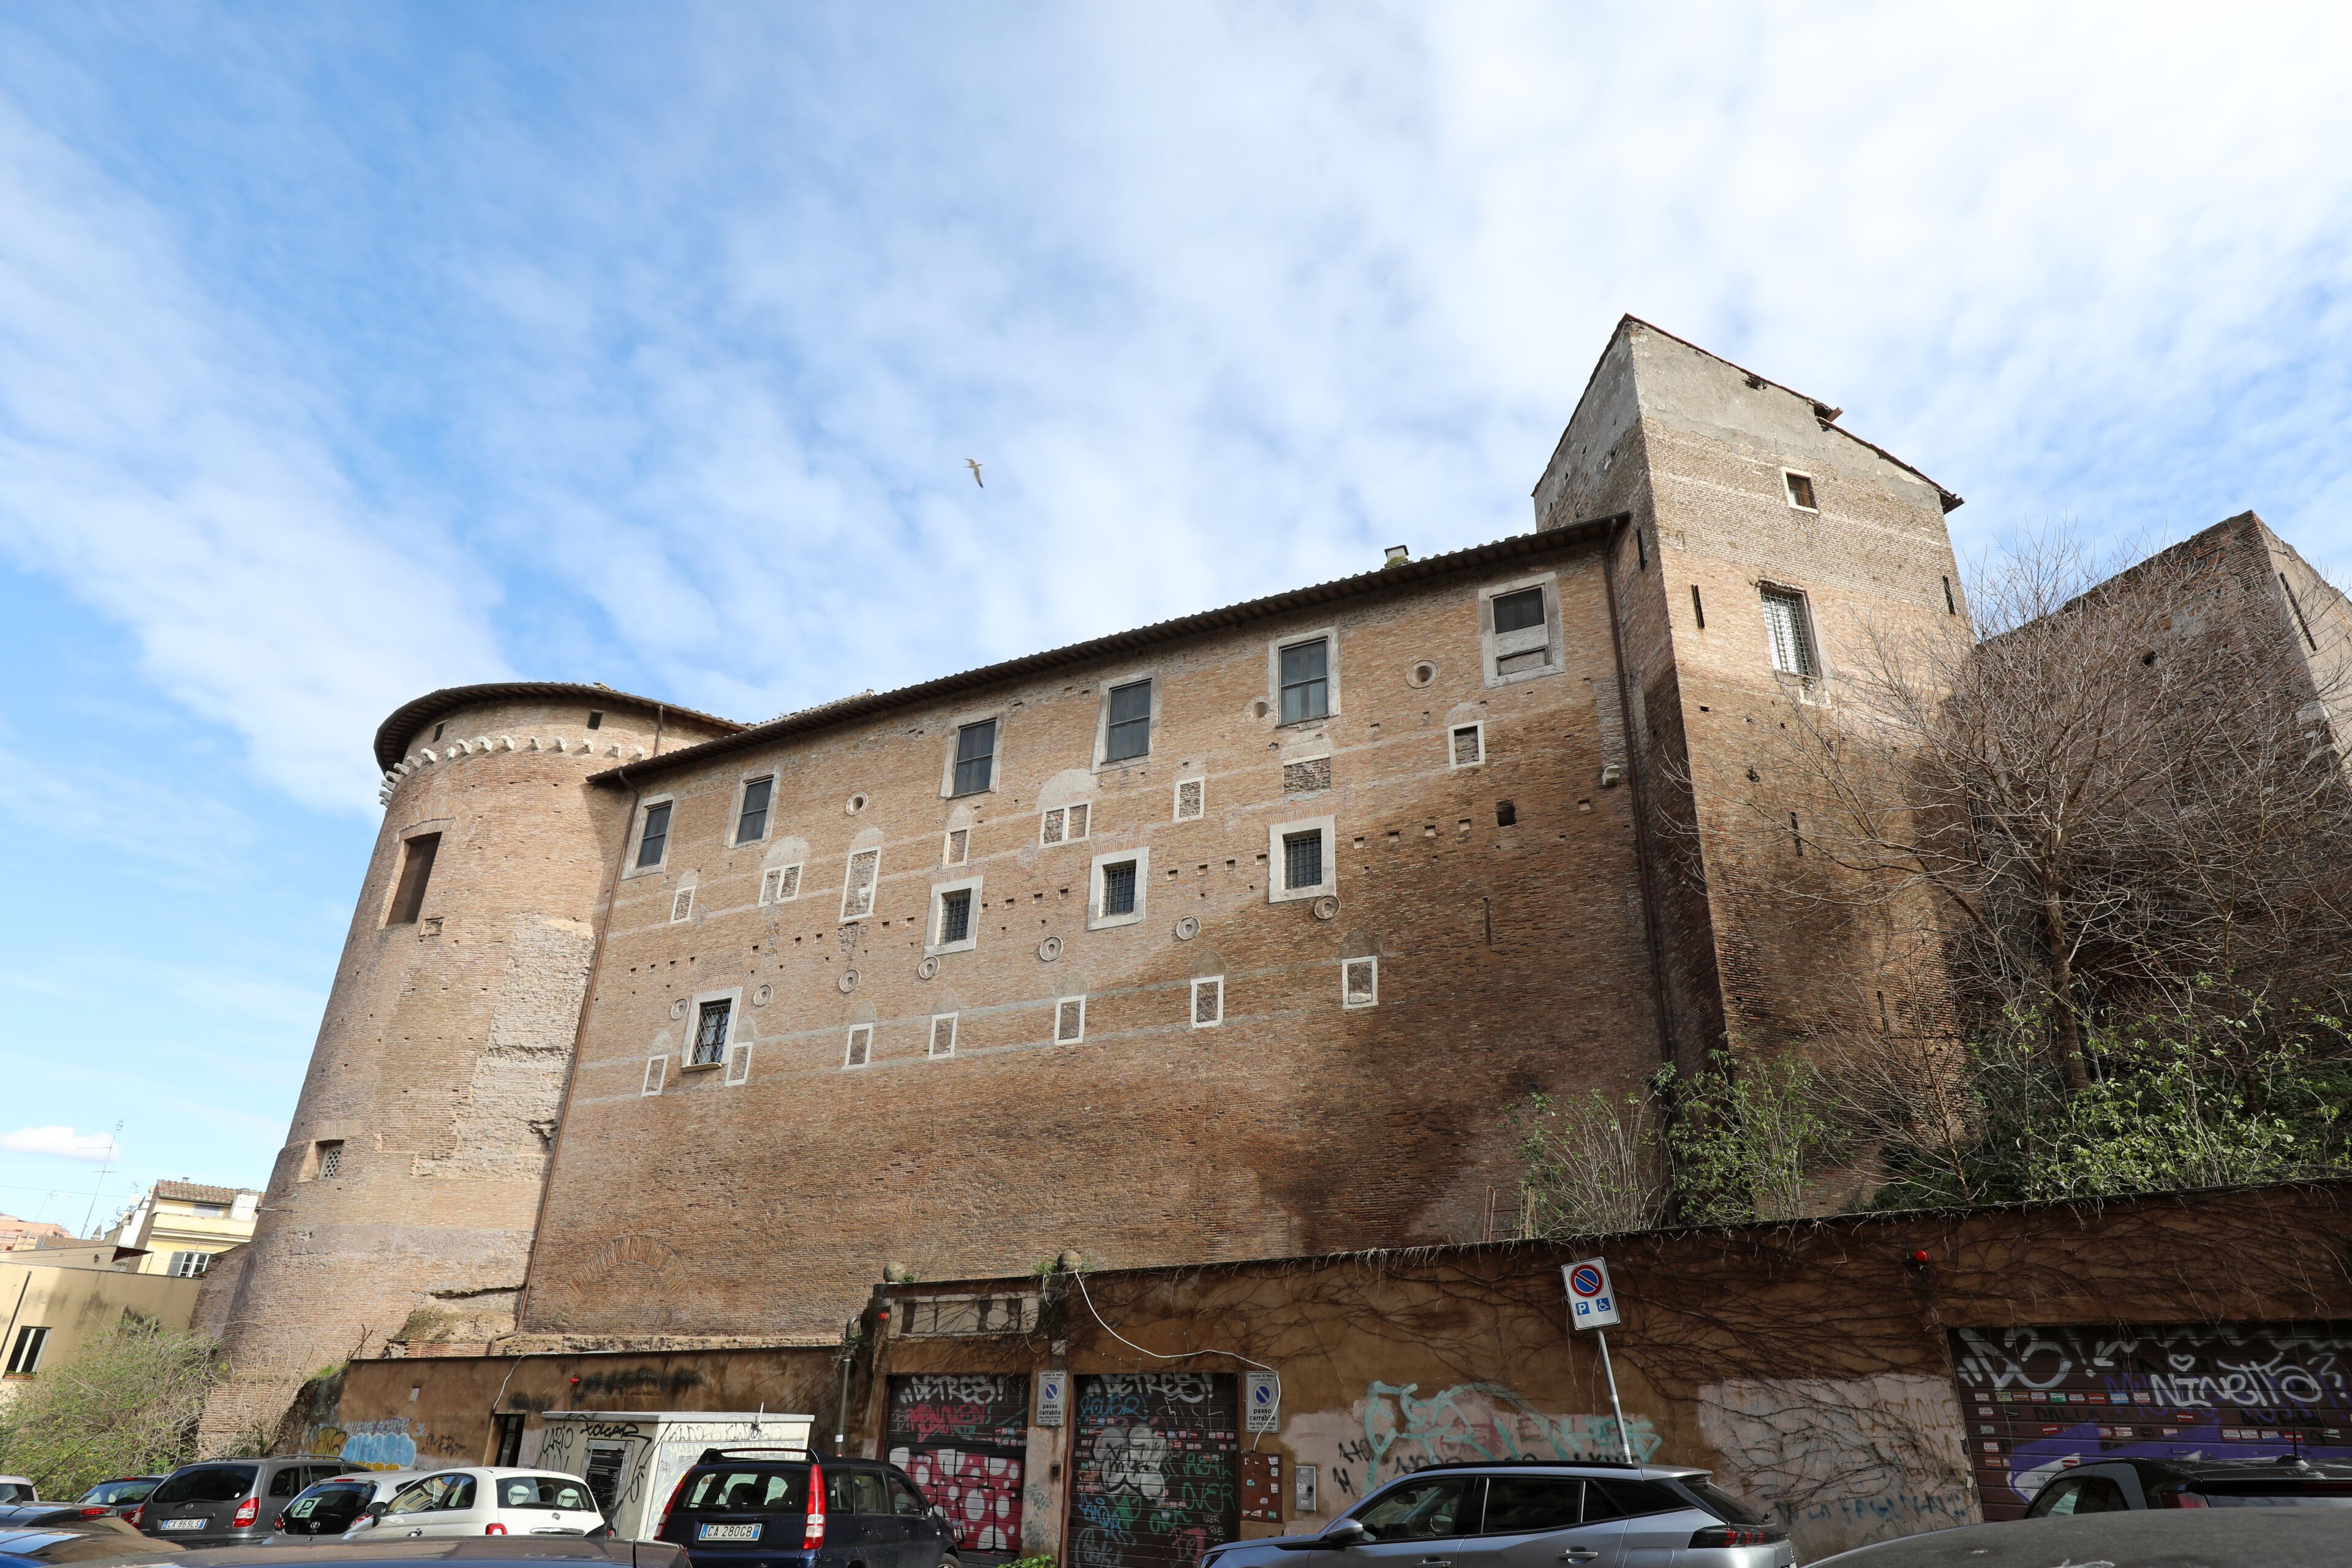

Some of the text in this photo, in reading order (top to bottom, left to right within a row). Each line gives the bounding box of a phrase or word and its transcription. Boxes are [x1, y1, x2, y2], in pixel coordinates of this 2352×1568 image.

[1578, 1303, 1586, 1314] P
[542, 1427, 573, 1454] LAZIO
[707, 1526, 718, 1537] CA
[722, 1526, 753, 1537] 280GB
